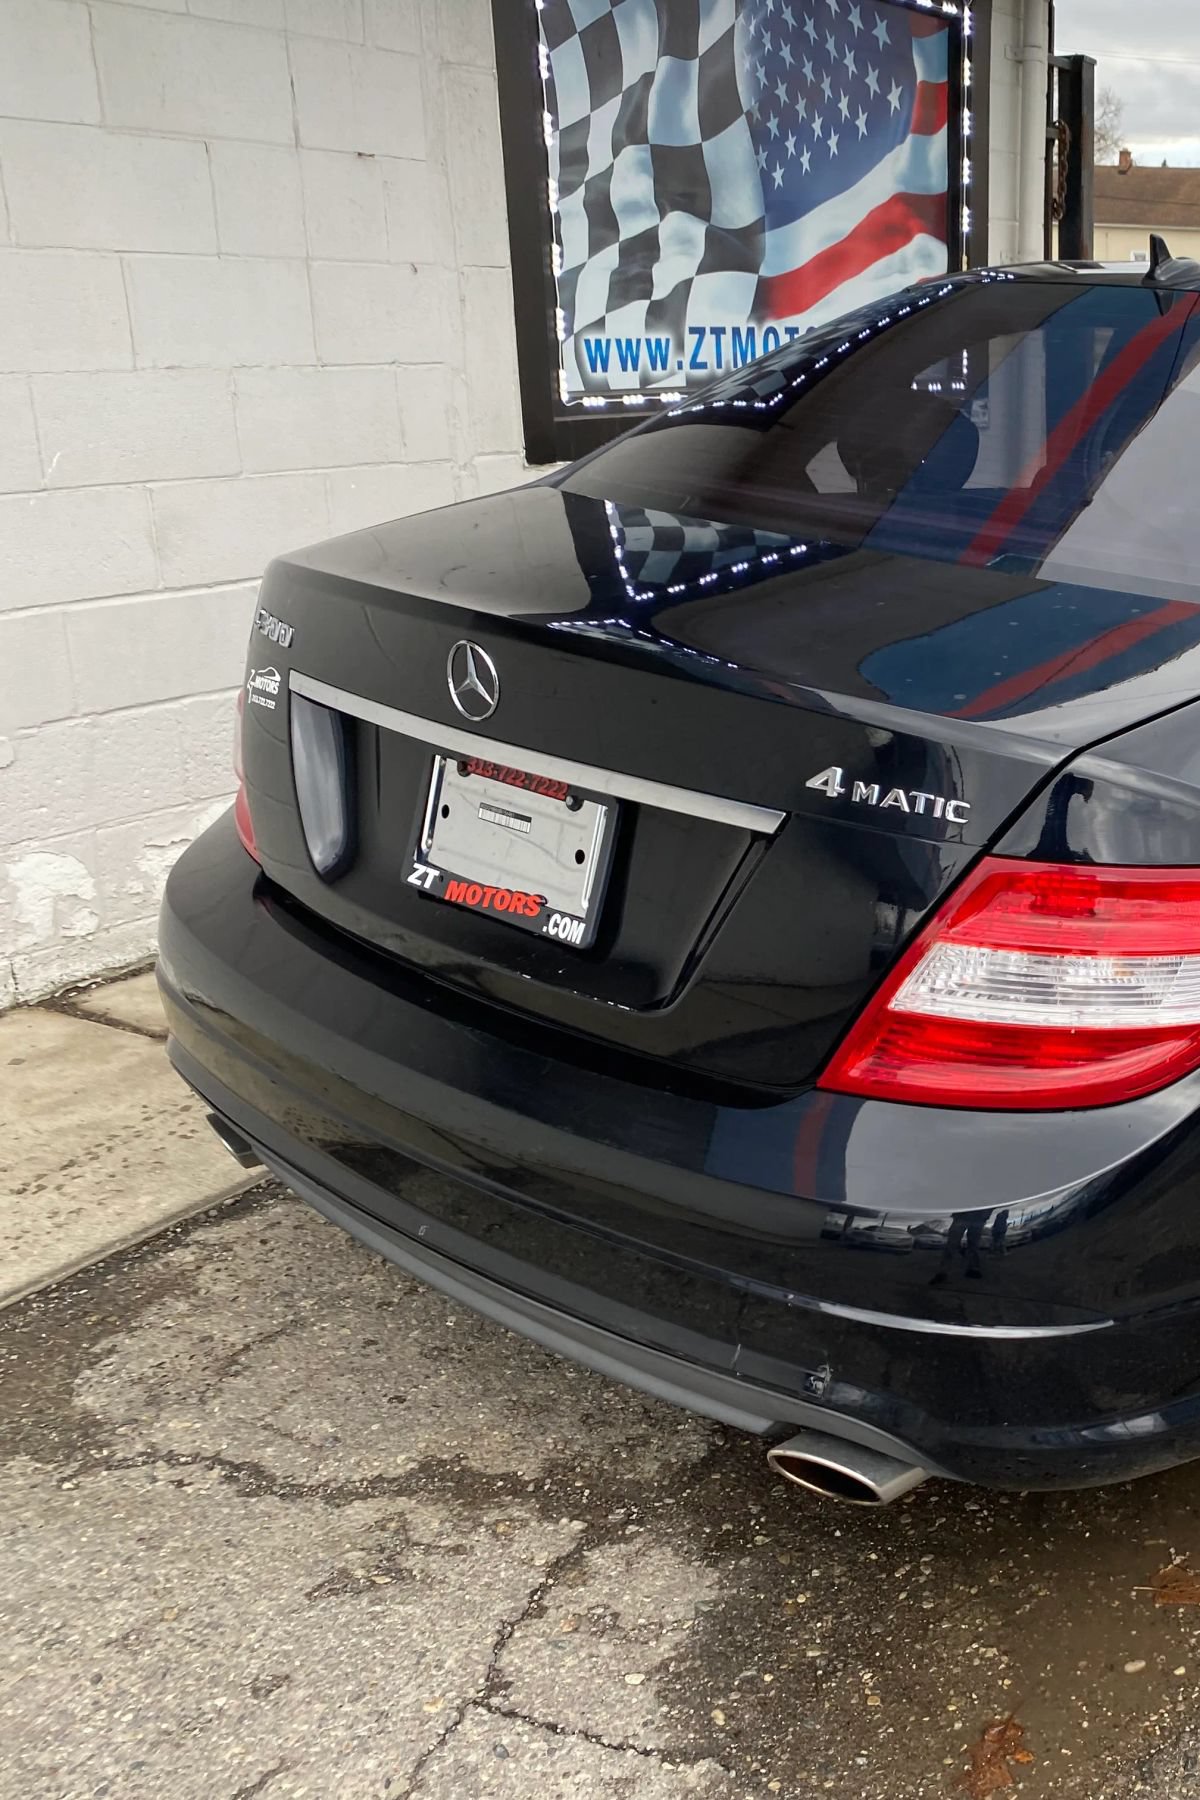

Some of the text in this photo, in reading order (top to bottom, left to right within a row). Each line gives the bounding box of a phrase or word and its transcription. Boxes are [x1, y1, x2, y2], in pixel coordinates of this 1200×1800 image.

[255, 675, 280, 695] MOTORS
[467, 756, 569, 801] 313-722-7222
[406, 862, 587, 945] ZT MOTORS .COM
